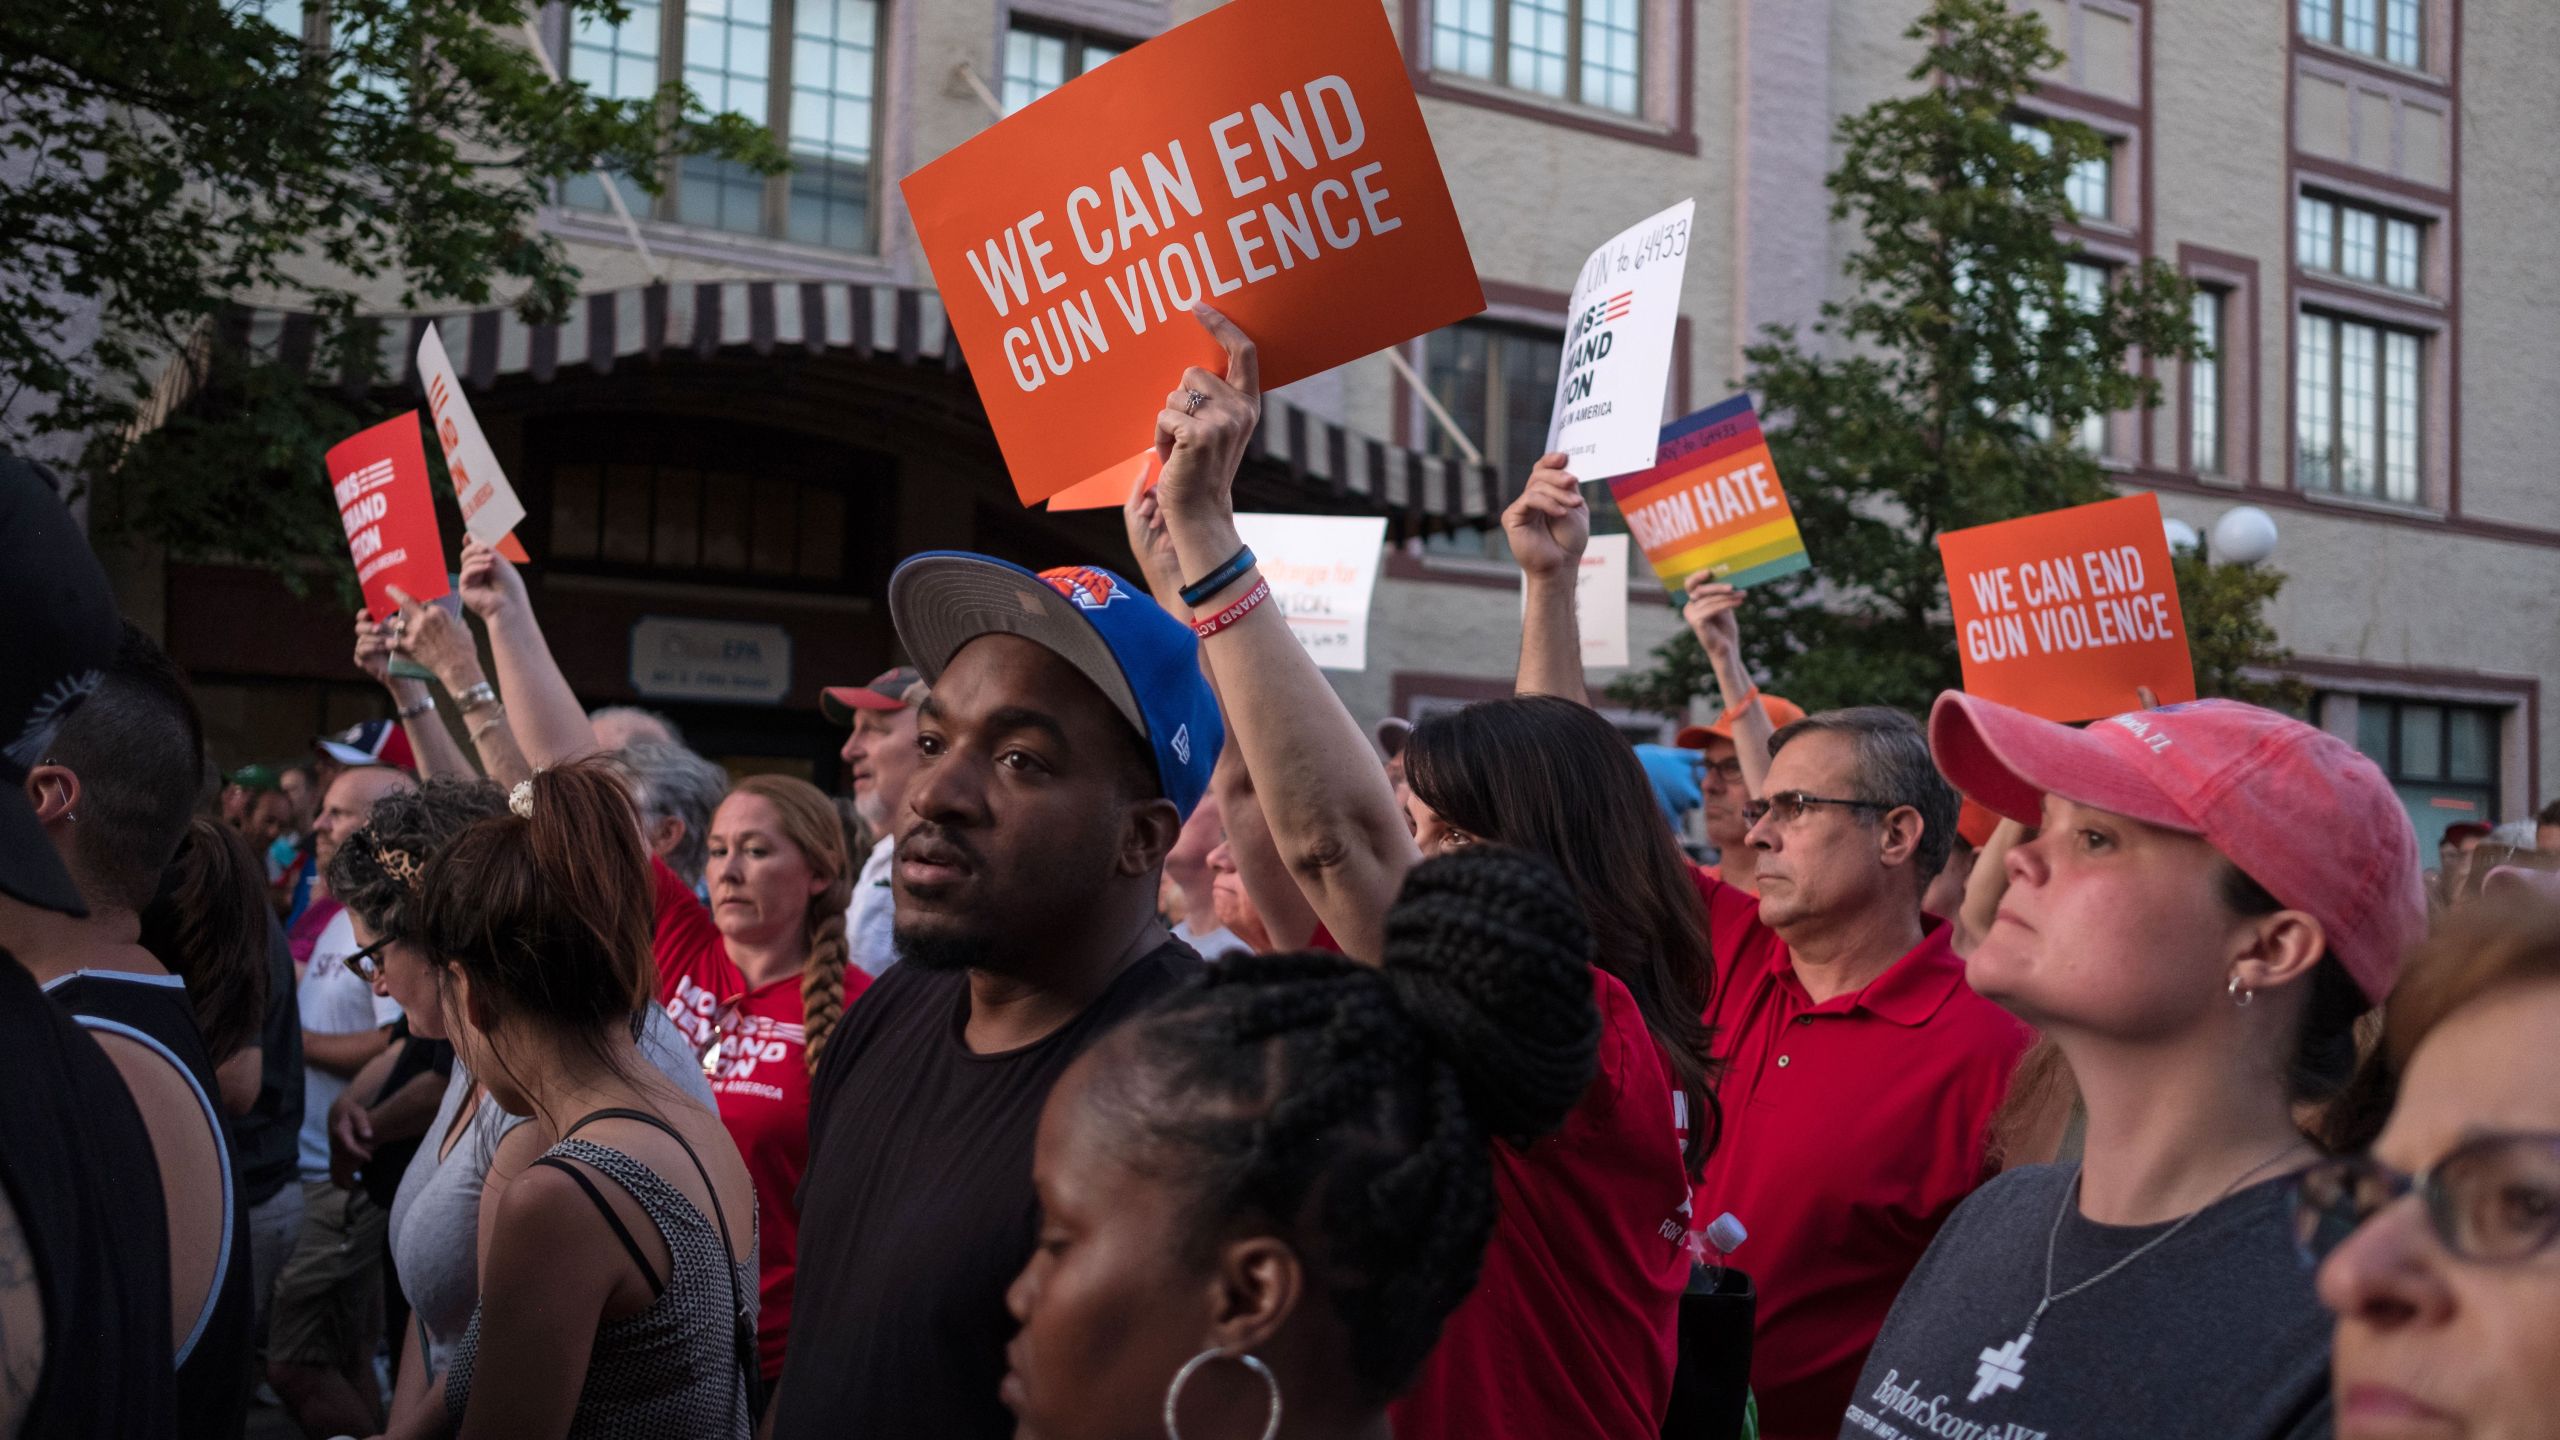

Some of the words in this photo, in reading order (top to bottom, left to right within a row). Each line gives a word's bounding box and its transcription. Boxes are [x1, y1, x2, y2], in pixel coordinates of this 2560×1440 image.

[966, 211, 1067, 317] WE
[1066, 139, 1202, 266] CAN
[1209, 75, 1366, 198] END
[1616, 242, 1630, 272] to
[1635, 219, 1687, 270] 64433
[1003, 289, 1110, 392] GUN
[1105, 161, 1402, 335] VIOLENCE
[1575, 400, 1613, 422] AMERICA
[1693, 462, 1780, 529] HATE
[1219, 582, 1269, 625] DEMAND
[1969, 567, 2018, 615] WE
[2018, 555, 2082, 608] CAN
[2082, 545, 2145, 598] END
[1966, 613, 2029, 664] GUN
[2030, 592, 2174, 655] VIOLENCE
[726, 1080, 784, 1101] AMERICA
[1658, 1217, 1679, 1241] FOR
